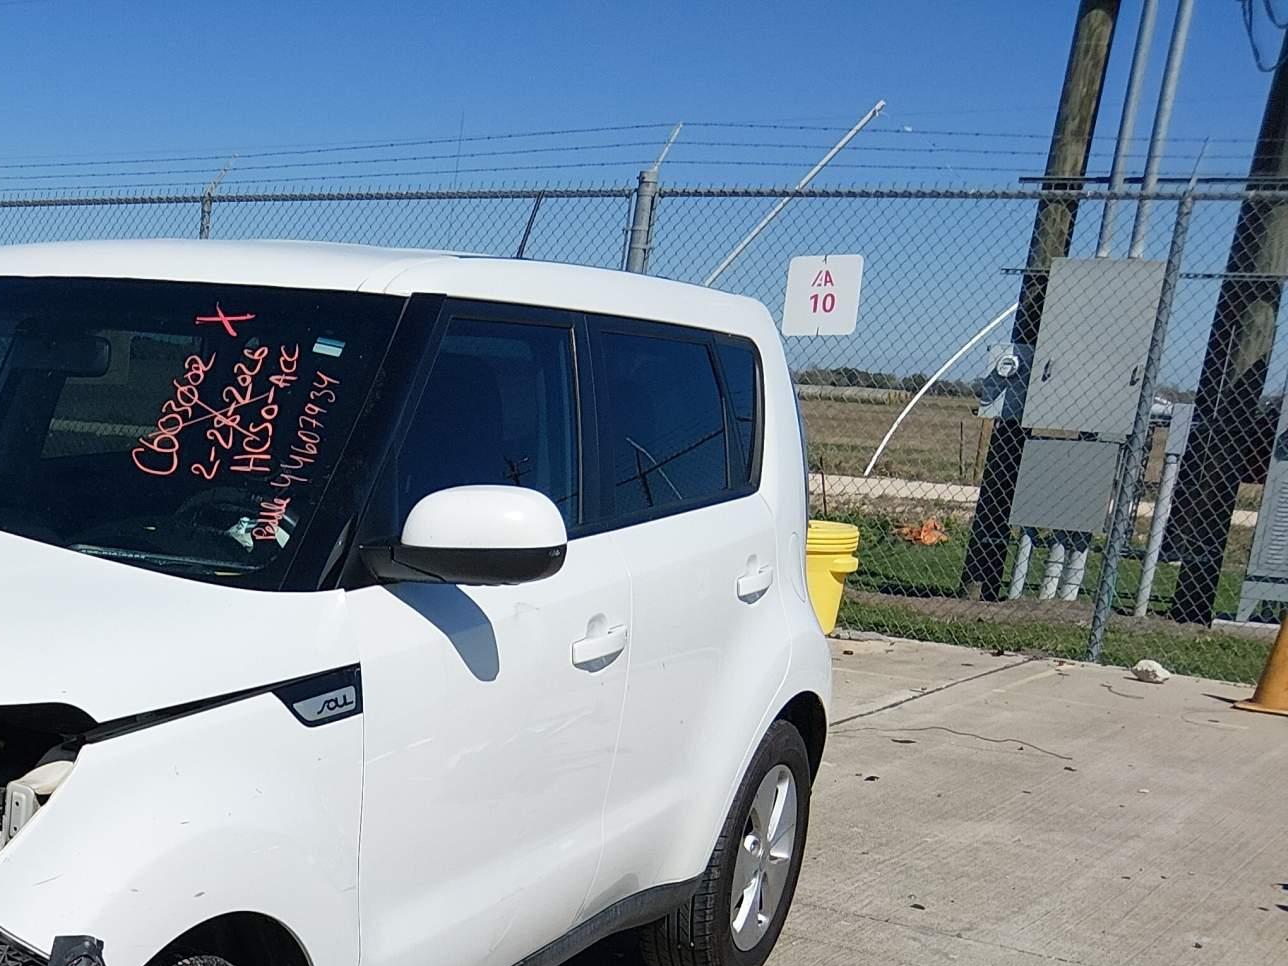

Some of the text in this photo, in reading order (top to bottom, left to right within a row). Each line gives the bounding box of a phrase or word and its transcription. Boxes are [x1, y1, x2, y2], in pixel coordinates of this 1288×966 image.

[809, 292, 836, 313] 10
[195, 301, 256, 337] X
[270, 370, 340, 487] 44607934
[317, 695, 353, 715] SOUL
